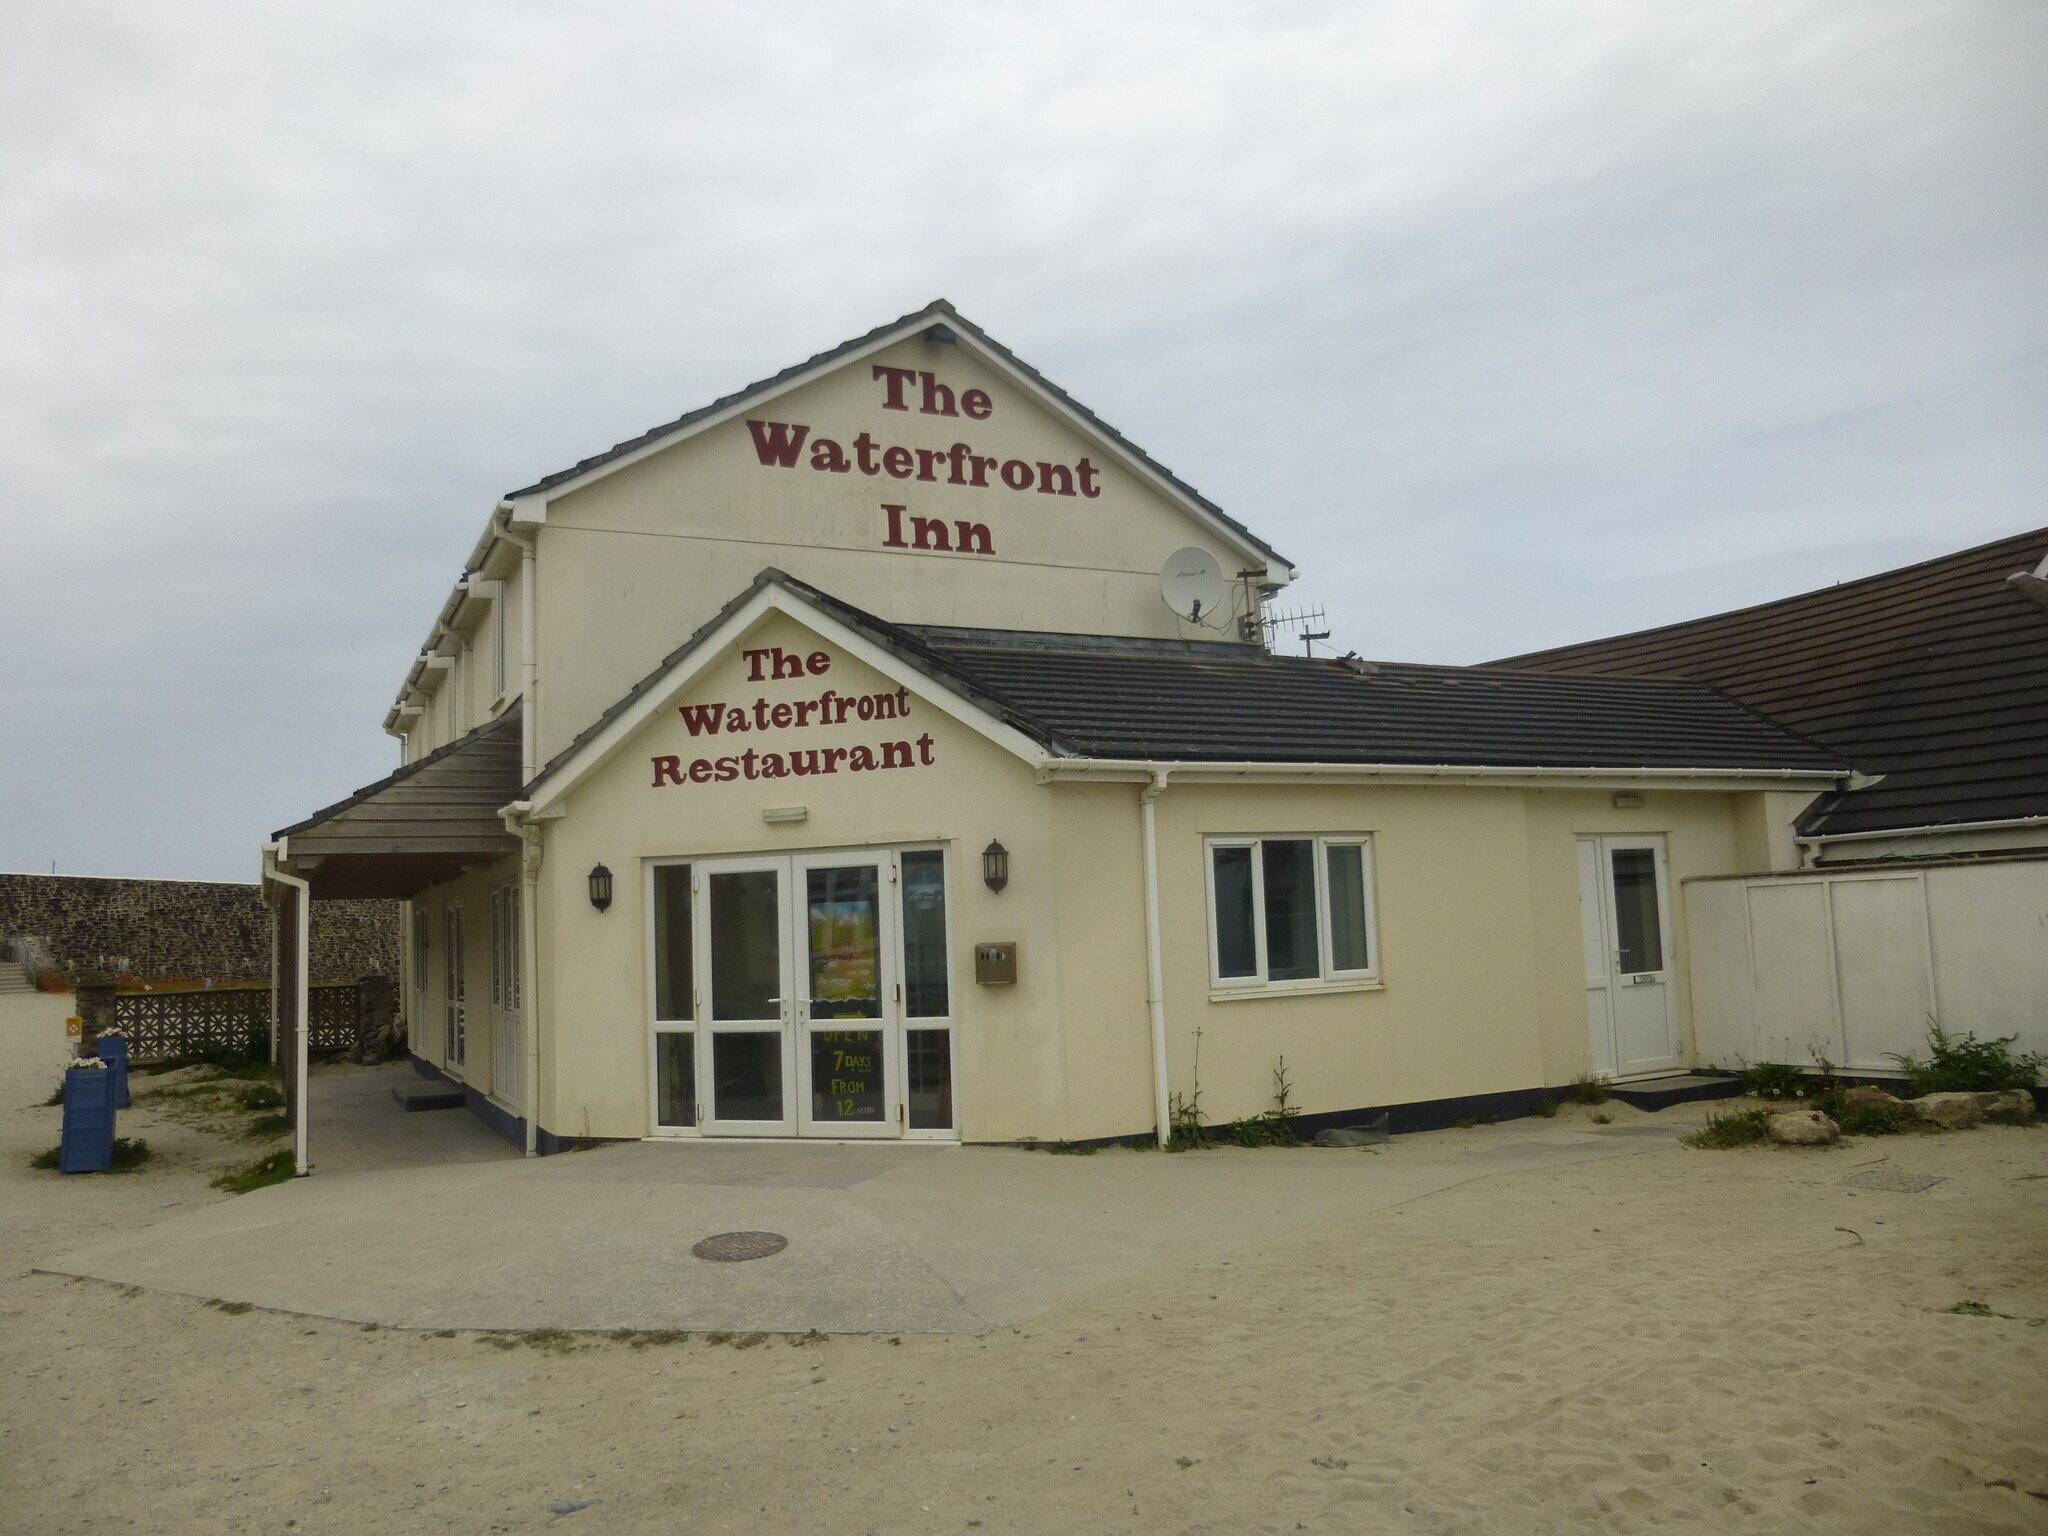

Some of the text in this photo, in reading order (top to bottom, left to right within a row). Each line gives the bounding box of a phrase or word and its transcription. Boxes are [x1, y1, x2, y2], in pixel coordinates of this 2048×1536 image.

[872, 365, 993, 420] The
[745, 420, 1101, 499] Waterfront
[880, 503, 996, 555] Inn
[742, 647, 831, 682] The
[678, 686, 911, 737] Waterfront
[651, 733, 935, 788] Restaurant
[831, 1078, 865, 1095] FROM
[833, 1050, 872, 1072] 7 DAYS
[836, 1098, 856, 1116] 12
